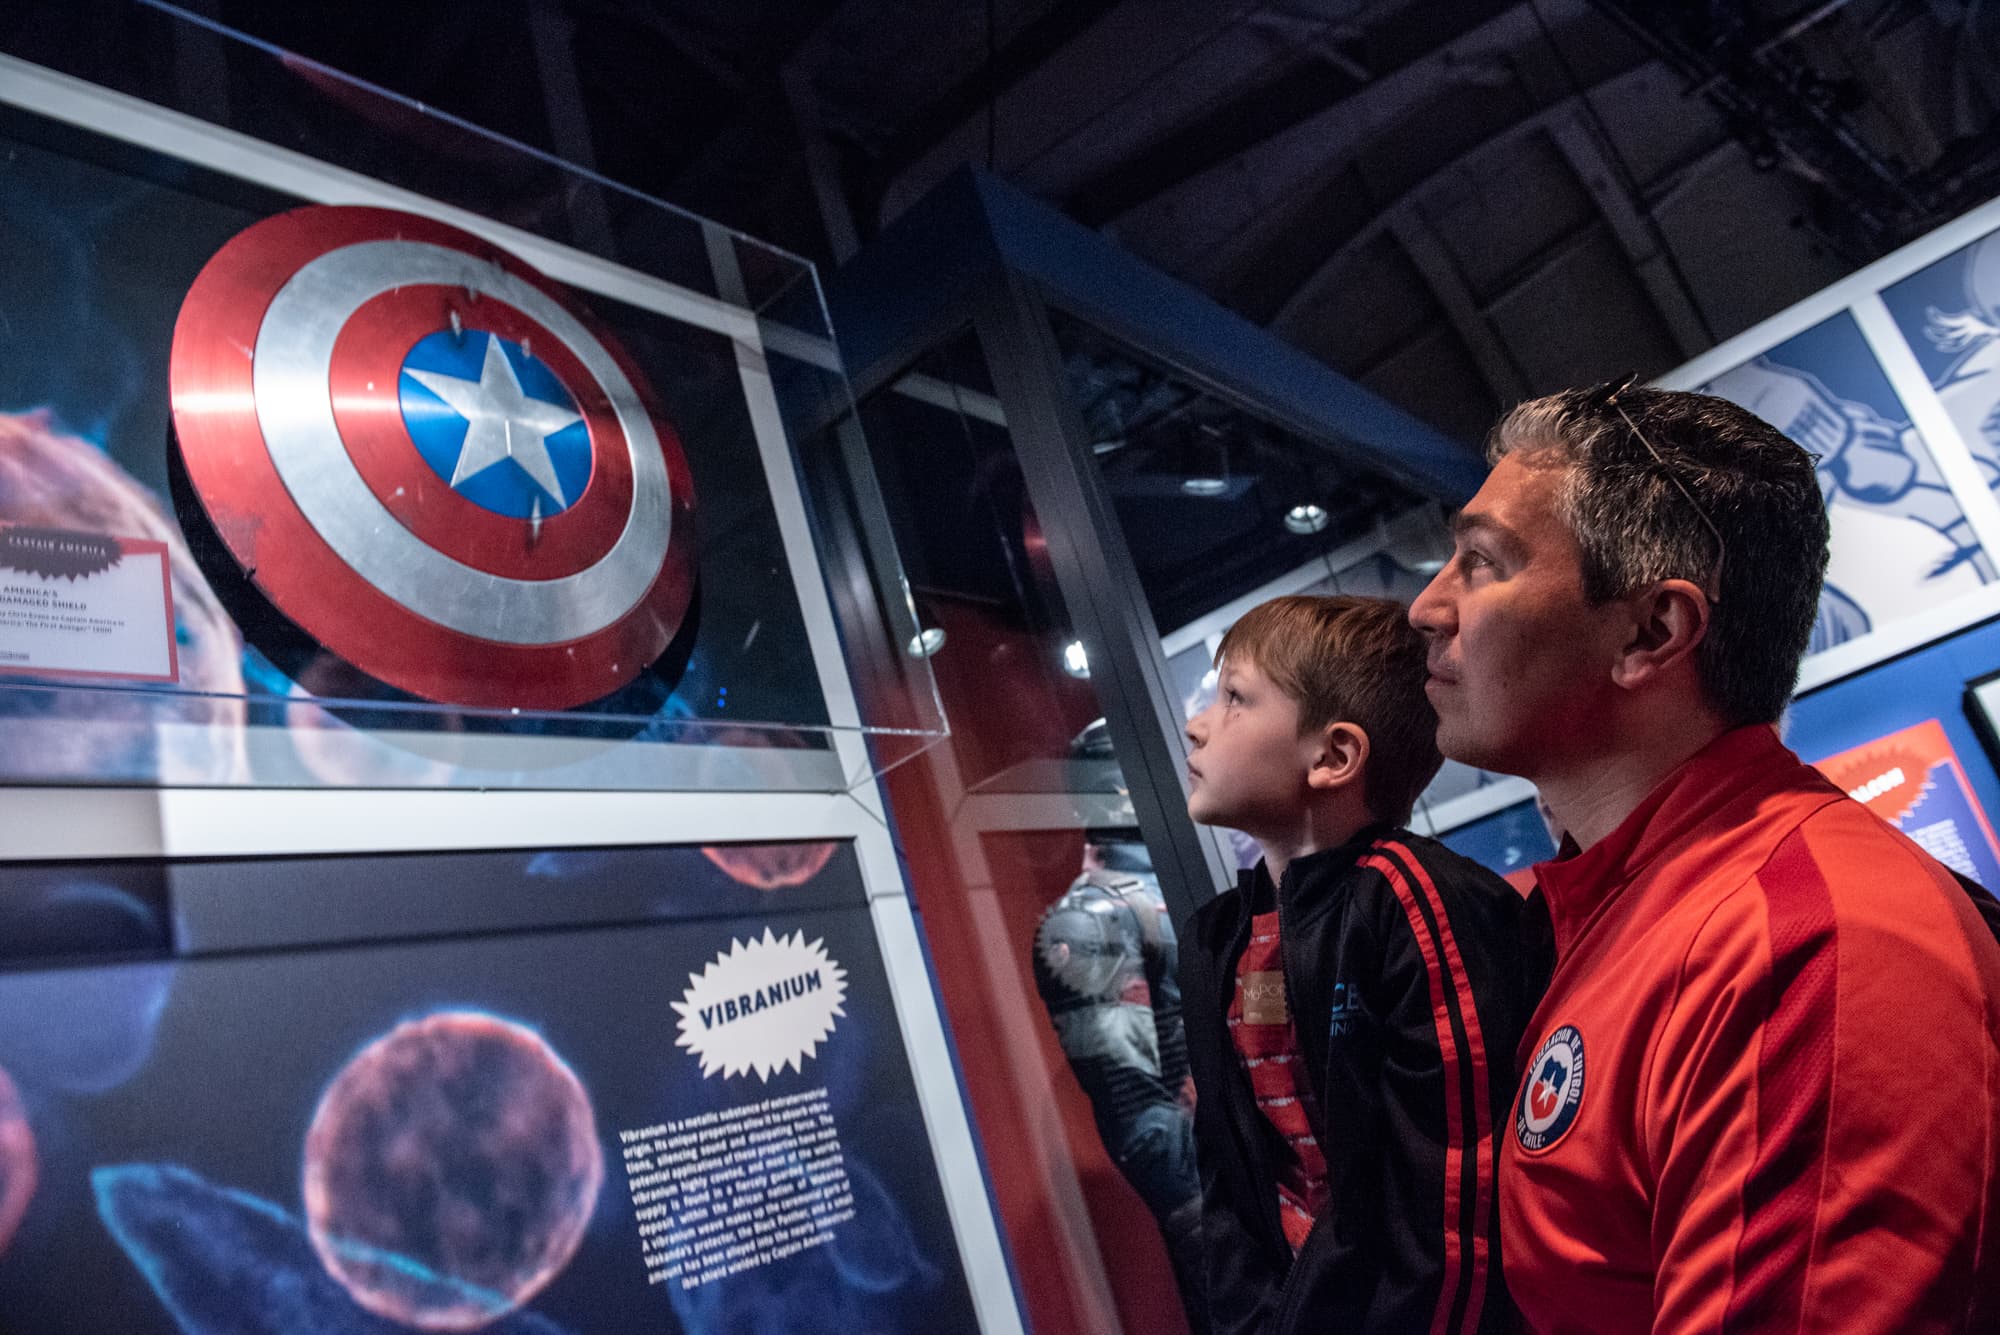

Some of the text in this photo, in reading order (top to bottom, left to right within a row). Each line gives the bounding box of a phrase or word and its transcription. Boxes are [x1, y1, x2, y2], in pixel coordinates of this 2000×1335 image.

[59, 541, 107, 556] AMERICA
[3, 585, 59, 599] AMERICA'S
[52, 599, 88, 611] SHIELD
[699, 969, 822, 1031] VIBRANIUM
[619, 1123, 667, 1142] Vibranium
[684, 1112, 718, 1128] metallic
[719, 1103, 760, 1120] substance
[622, 1142, 652, 1159] origin.
[668, 1132, 698, 1149] unique
[699, 1122, 742, 1141] properties
[743, 1117, 764, 1130] allow
[782, 1107, 807, 1121] absorb
[657, 1147, 697, 1166] silencing
[700, 1140, 726, 1154] sound
[748, 1124, 792, 1144] dissipating
[794, 1118, 817, 1131] force.
[628, 1168, 670, 1189] potential
[671, 1155, 722, 1178] applications
[734, 1147, 756, 1161] these
[757, 1137, 797, 1156] properties
[798, 1132, 816, 1145] have
[817, 1127, 837, 1140] made
[631, 1183, 678, 1204] vibranium
[680, 1175, 707, 1192] highly
[710, 1165, 744, 1184] coveted,
[766, 1155, 785, 1168] most
[814, 1140, 840, 1155] world's
[635, 1202, 667, 1221] supply
[683, 1190, 709, 1206] found
[735, 1174, 767, 1193] fiercely
[770, 1164, 803, 1183] guarded
[637, 1215, 674, 1236] deposit
[679, 1206, 707, 1223] within
[732, 1191, 763, 1208] African
[767, 1182, 793, 1198] nation
[644, 1243, 691, 1267] Wakanda's
[694, 1229, 736, 1252] protector,
[754, 1217, 775, 1232] Black
[777, 1207, 809, 1226] Panther,
[834, 1193, 854, 1207] small
[647, 1263, 682, 1283] amount
[702, 1250, 723, 1265] been
[757, 1234, 773, 1248] into
[790, 1221, 814, 1238] nearly
[651, 1225, 695, 1248] vibranium
[725, 1209, 751, 1225] makes
[681, 1274, 699, 1289] ible
[701, 1265, 726, 1282] shield
[728, 1254, 759, 1273] wielded
[771, 1240, 801, 1259] Captain
[803, 1228, 835, 1247] America.
